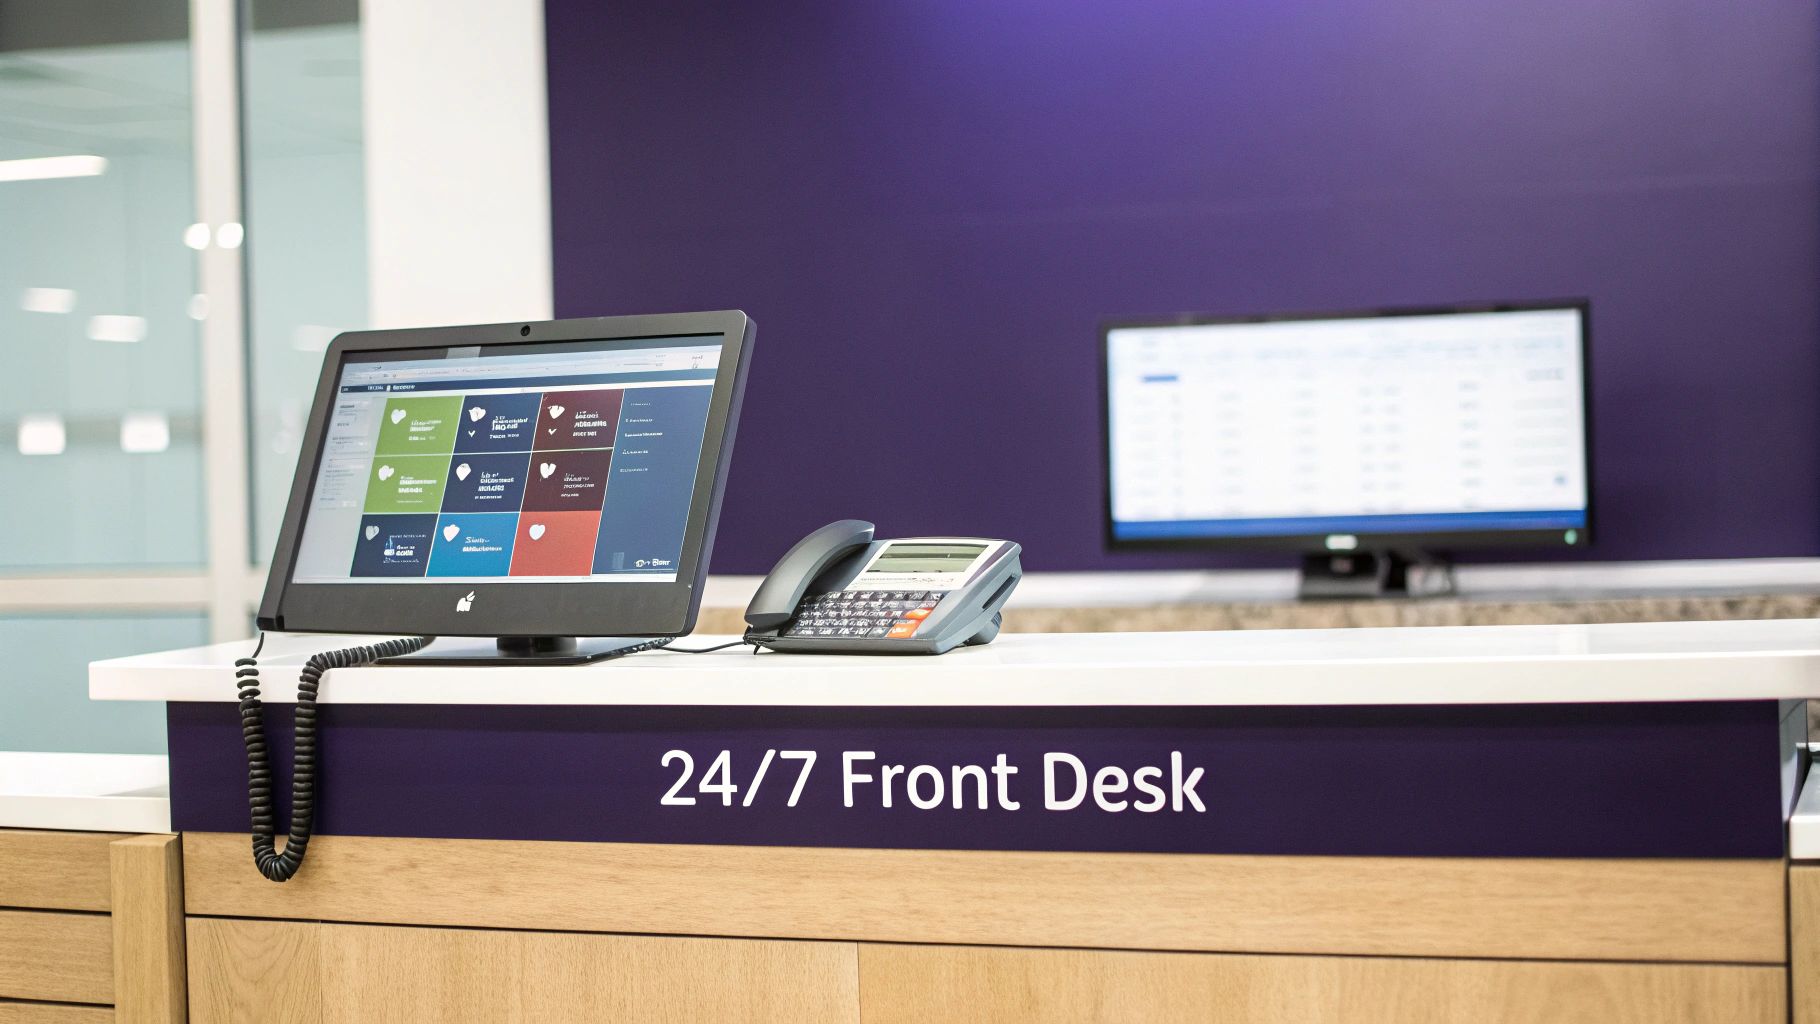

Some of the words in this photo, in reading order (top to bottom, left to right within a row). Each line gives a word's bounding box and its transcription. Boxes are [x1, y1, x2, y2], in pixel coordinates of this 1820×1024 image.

[661, 749, 817, 807] 24/7
[843, 751, 1020, 810] Front
[1044, 751, 1206, 812] Desk
